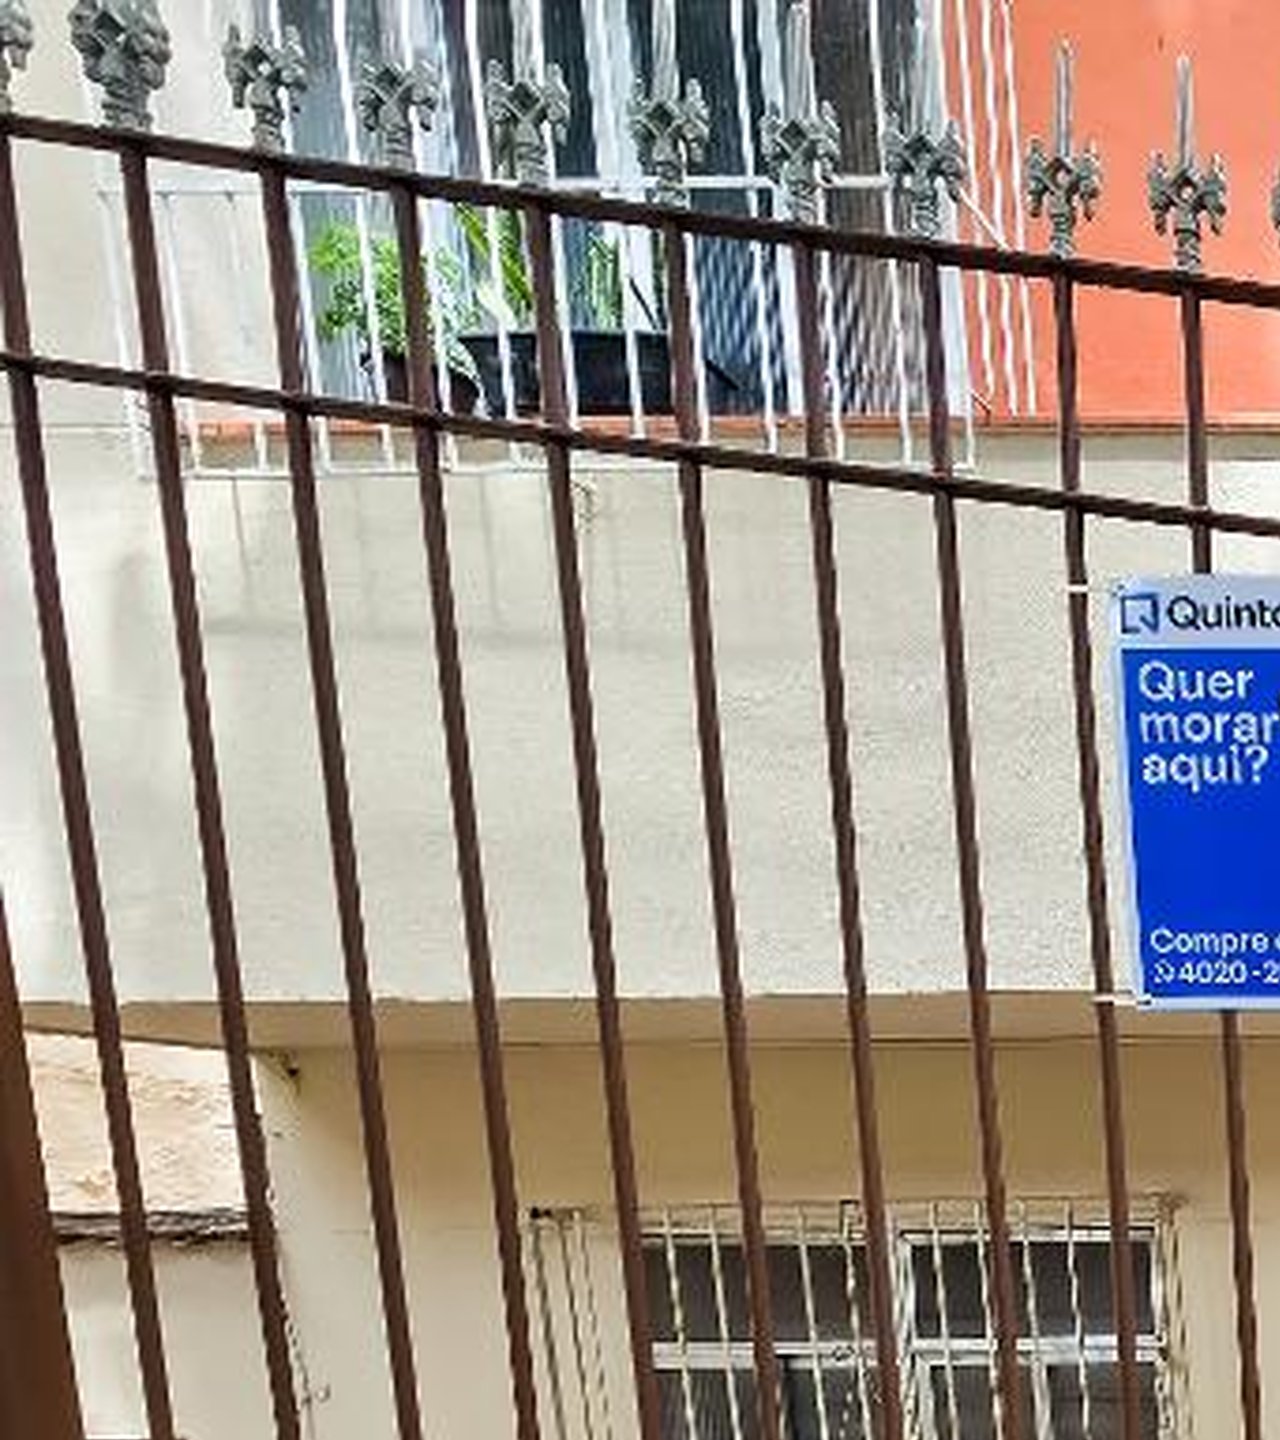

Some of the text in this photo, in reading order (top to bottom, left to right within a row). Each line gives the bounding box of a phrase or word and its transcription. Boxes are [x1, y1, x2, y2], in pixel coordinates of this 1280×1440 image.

[1139, 660, 1254, 702] Quer
[1139, 711, 1280, 744] morar
[1143, 745, 1269, 793] aqui?
[1151, 928, 1268, 958] Compre
